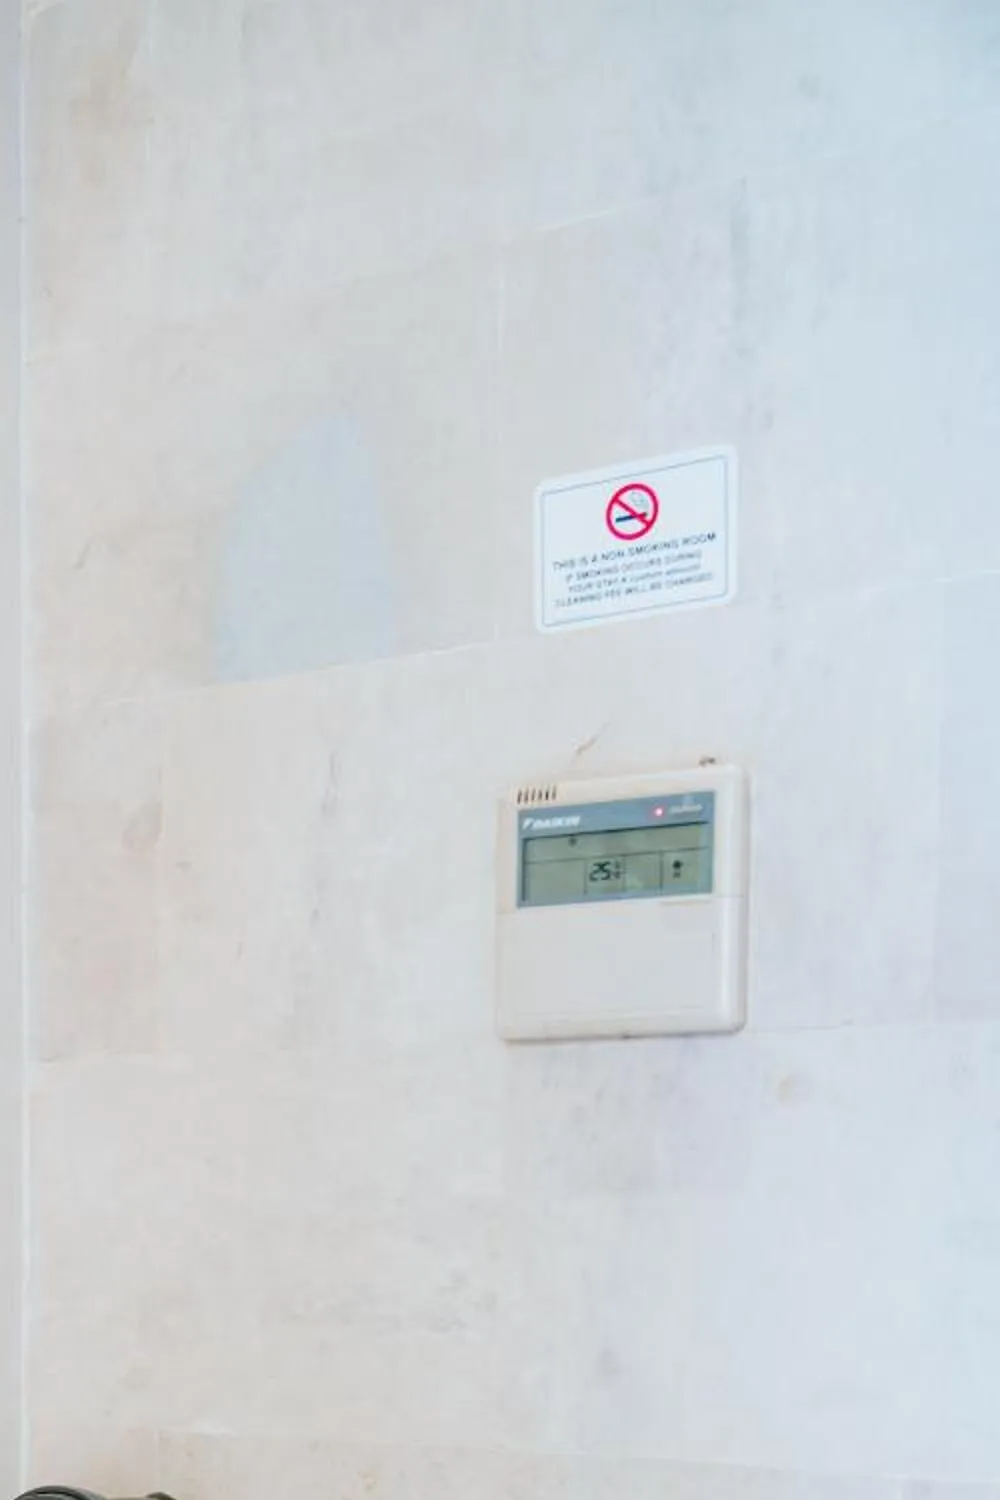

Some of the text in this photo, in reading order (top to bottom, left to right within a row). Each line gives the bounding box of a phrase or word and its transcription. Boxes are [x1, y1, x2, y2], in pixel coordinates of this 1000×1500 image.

[591, 553, 598, 563] A
[627, 541, 679, 557] SMOKING
[682, 532, 716, 546] ROOM
[589, 860, 611, 882] 25
